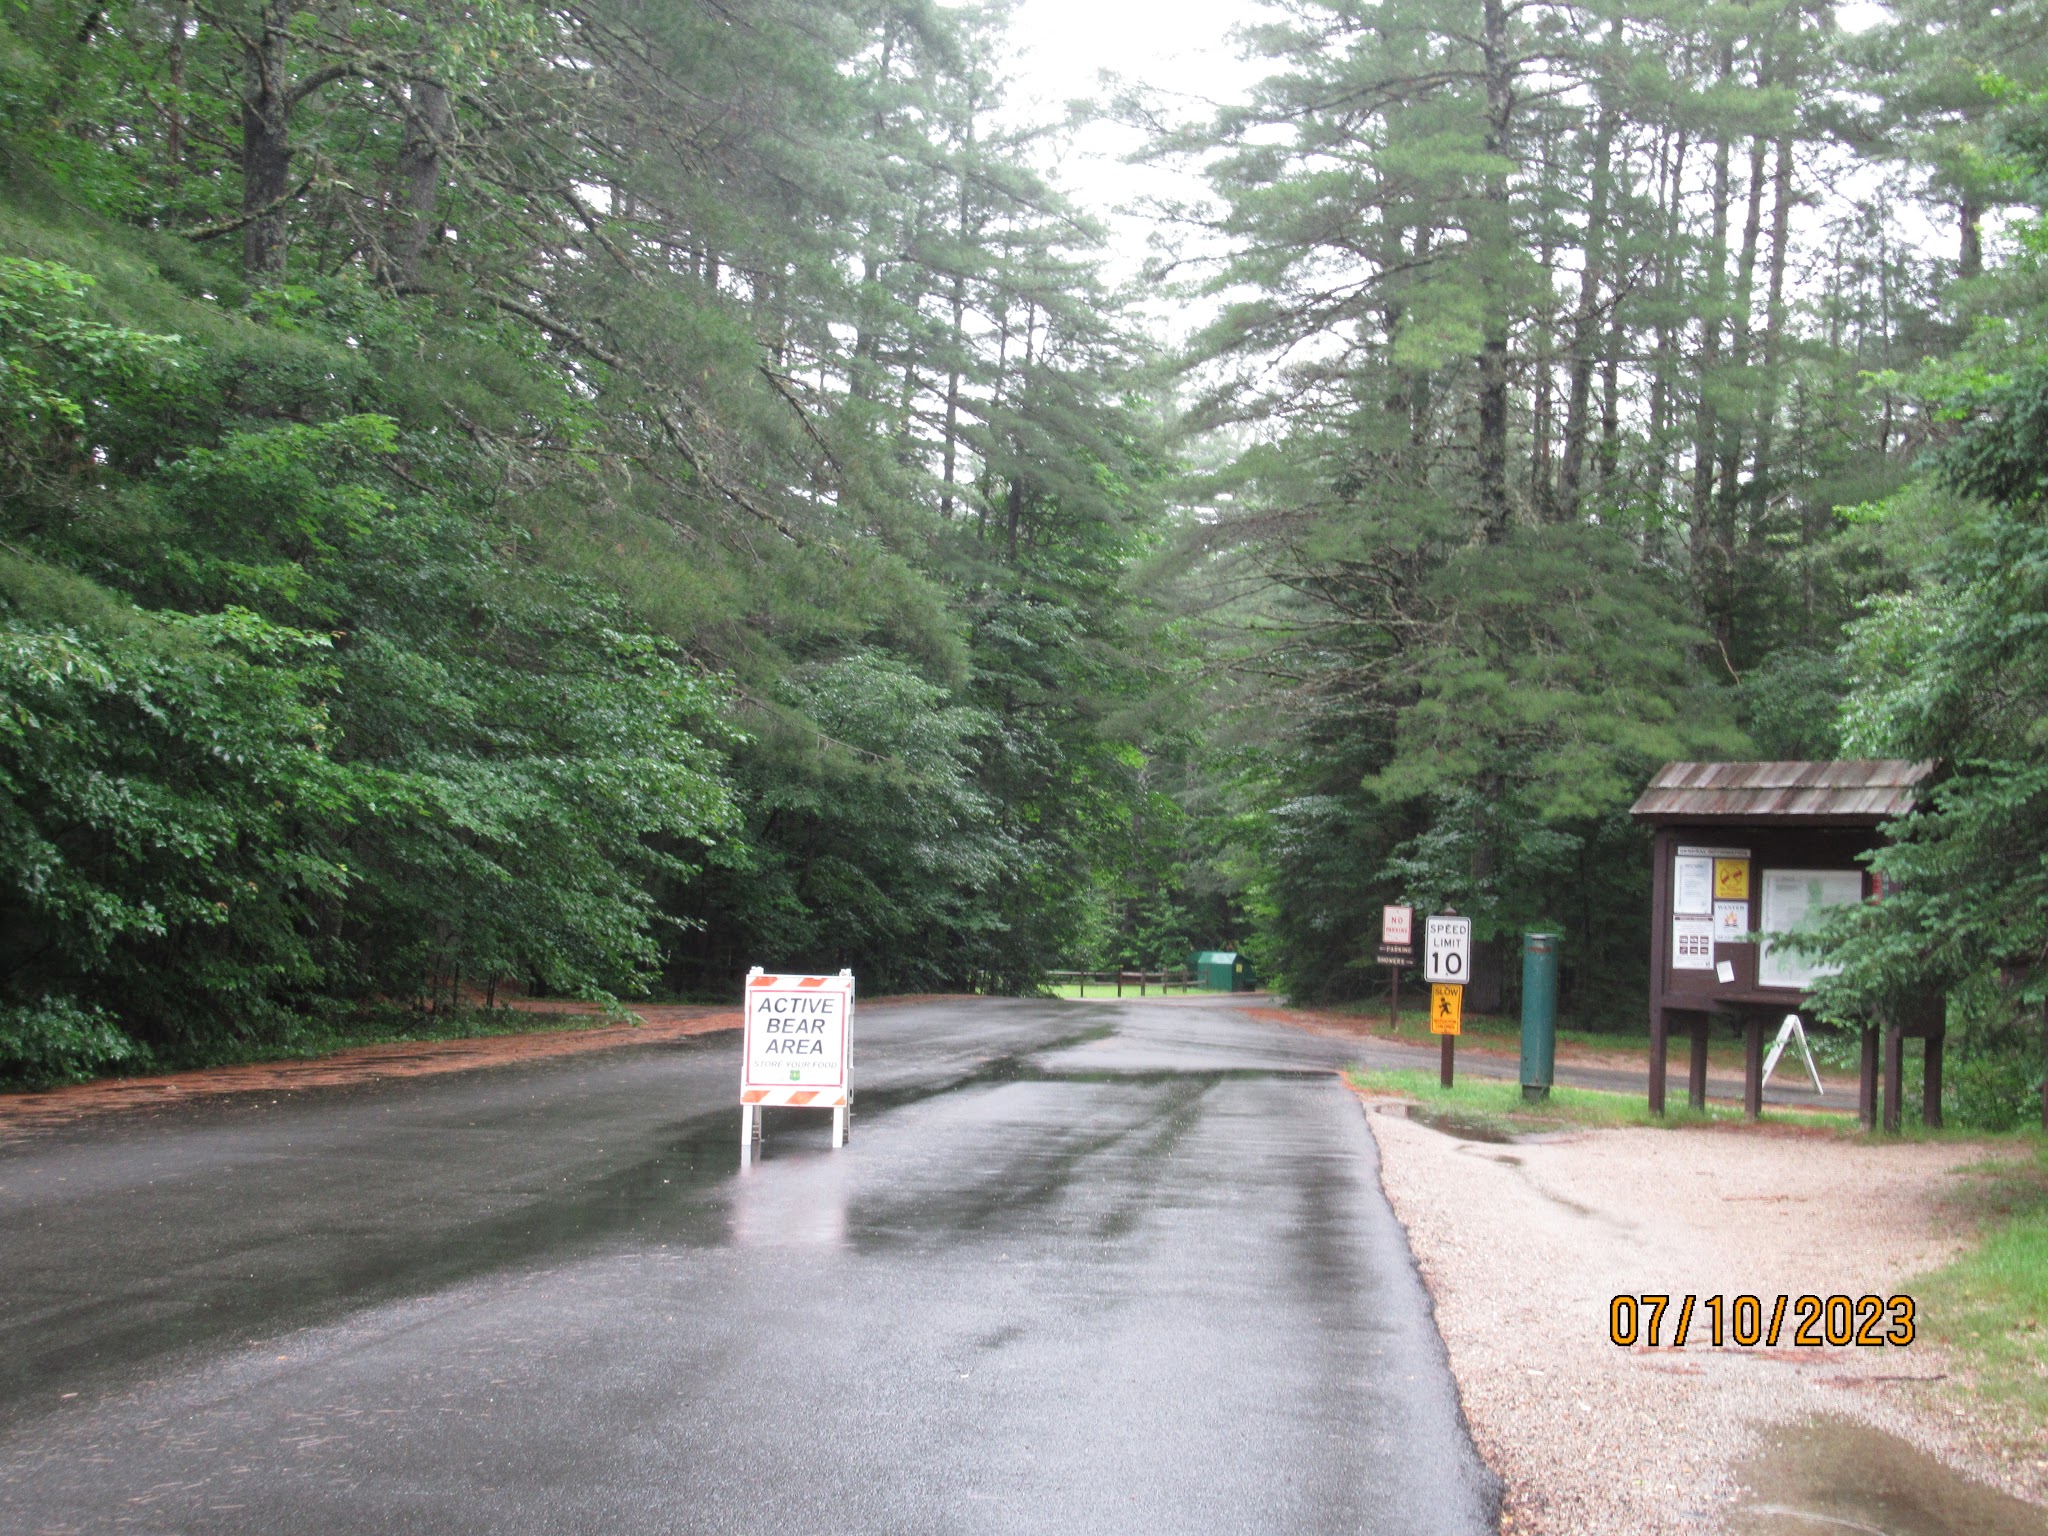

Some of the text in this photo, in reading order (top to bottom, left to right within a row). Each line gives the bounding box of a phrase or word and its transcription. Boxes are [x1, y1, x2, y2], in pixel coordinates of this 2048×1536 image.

[1430, 923, 1467, 935] SPEED
[1433, 937, 1462, 948] LIMIT
[1386, 946, 1412, 954] PARKING
[1377, 956, 1405, 965] SHOWERS
[1432, 952, 1462, 975] 10
[1434, 988, 1459, 997] SLOW
[757, 997, 835, 1014] ACTIVE
[766, 1018, 826, 1034] BEAR
[765, 1039, 824, 1055] AREA
[753, 1060, 838, 1069] STORE YOUR FOOD
